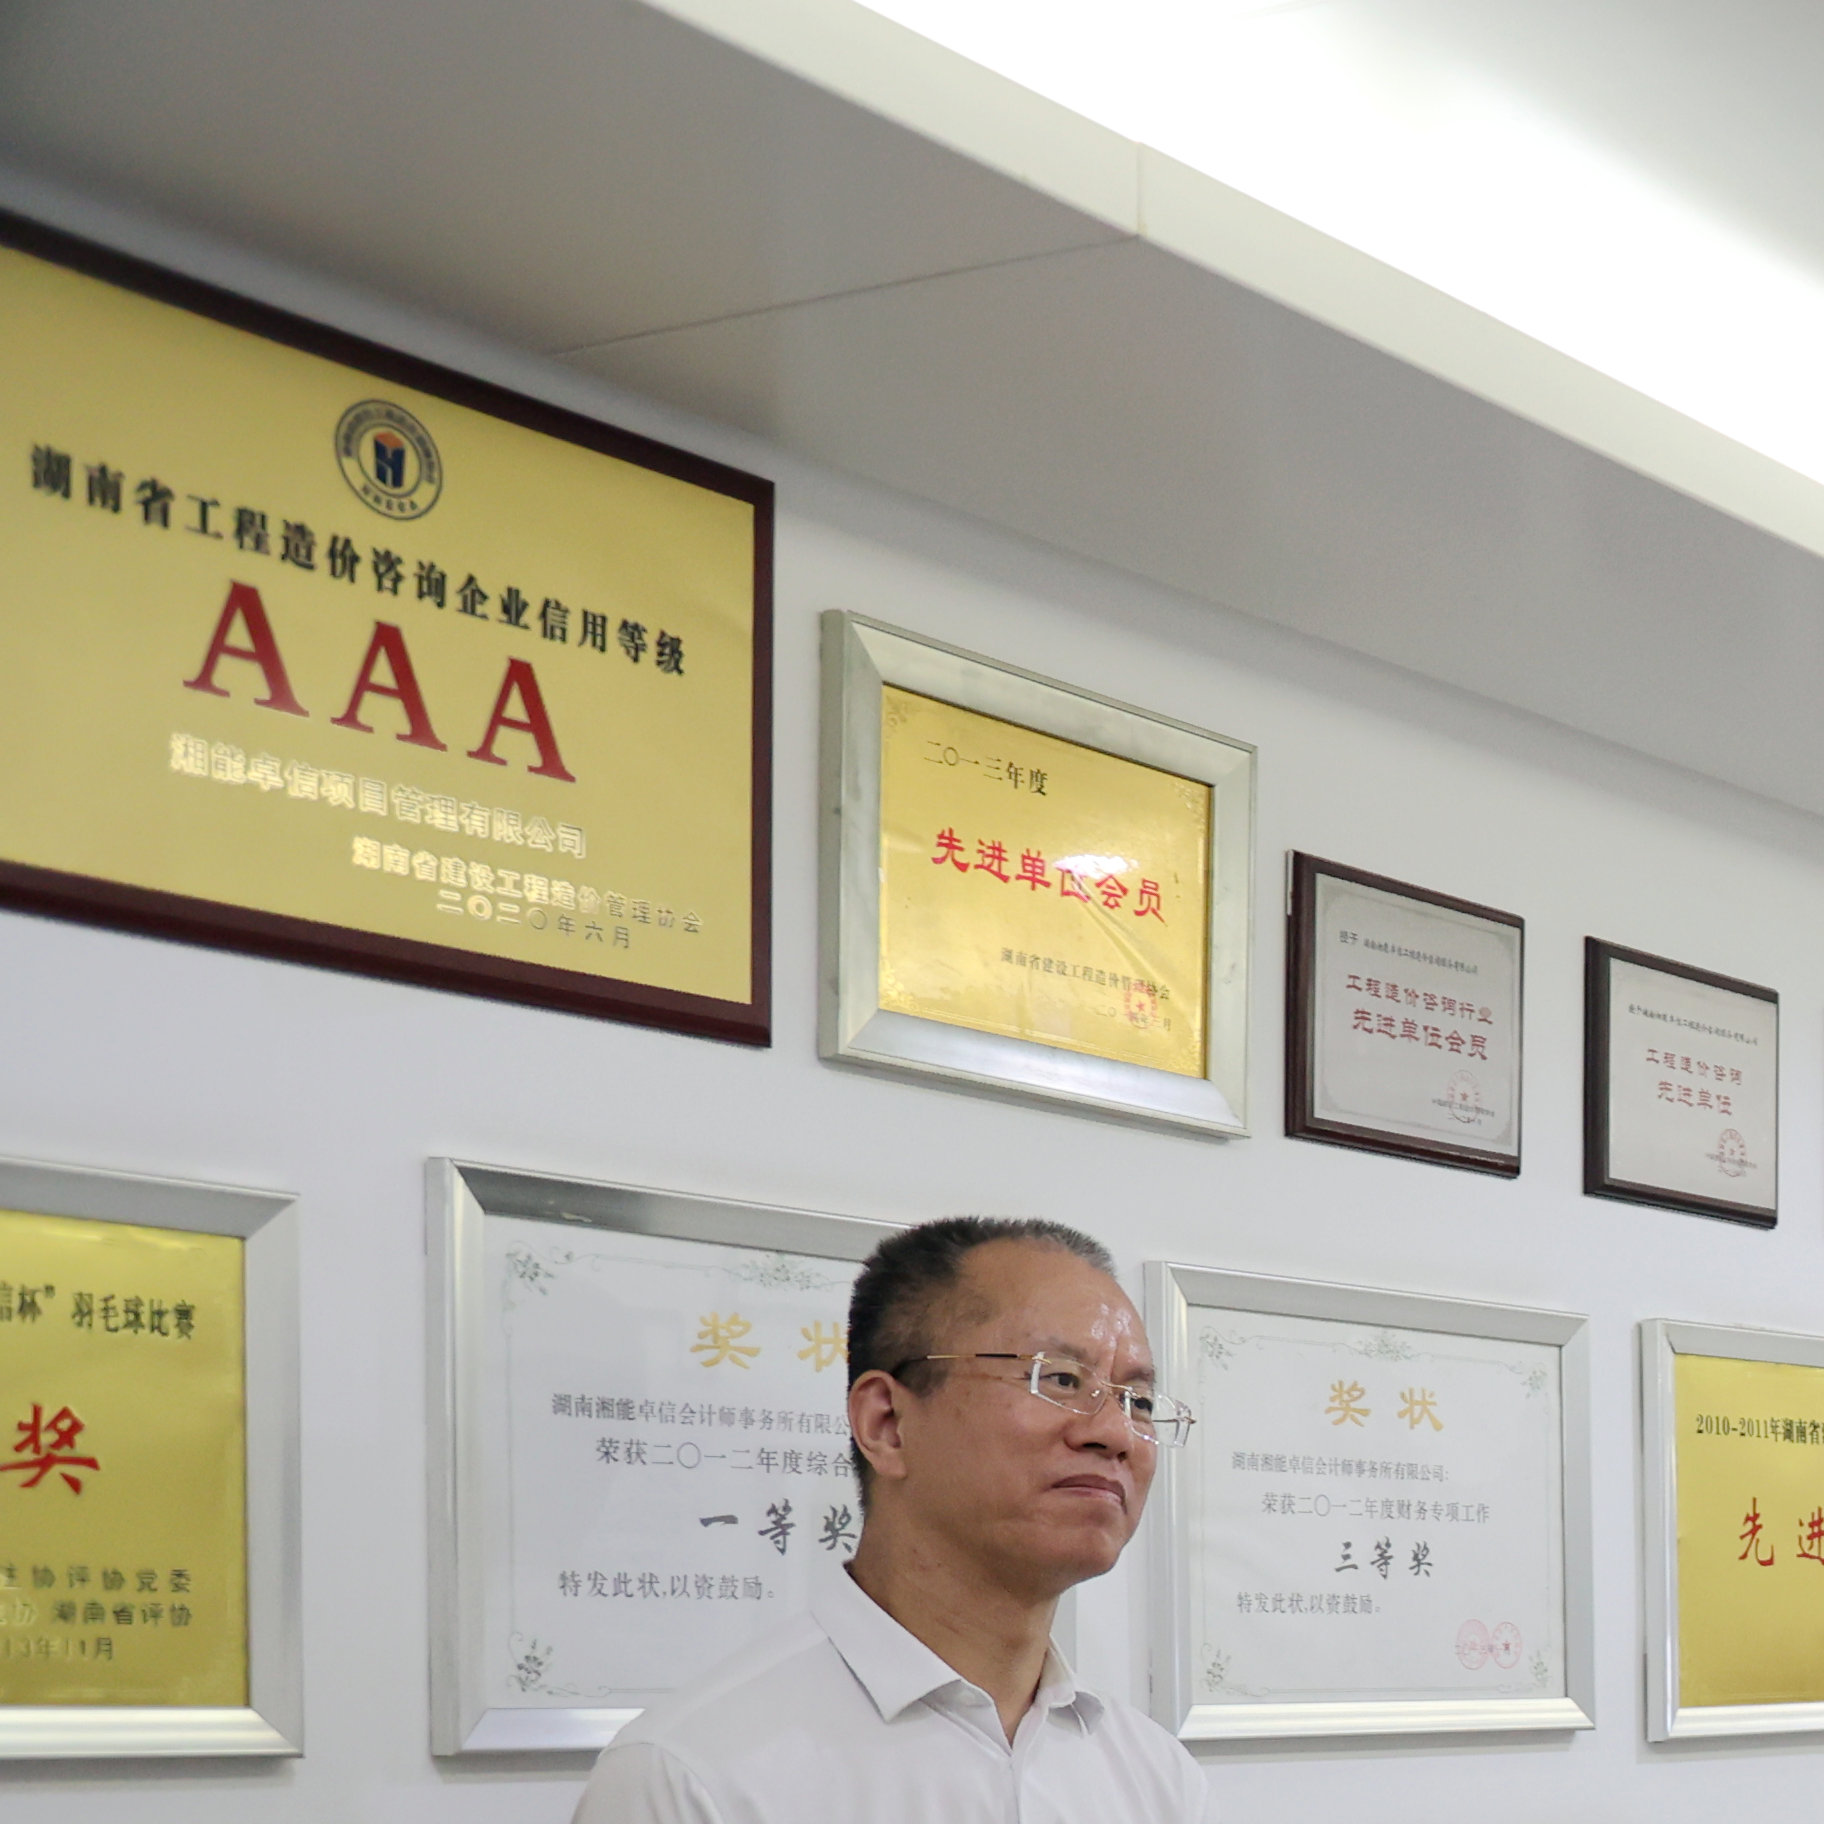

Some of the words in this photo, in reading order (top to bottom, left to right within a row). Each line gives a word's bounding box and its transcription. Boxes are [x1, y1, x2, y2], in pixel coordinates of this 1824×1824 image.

[31, 443, 687, 676] 湖南省工程造价咨询企业信用等级
[183, 579, 577, 785] AAA
[923, 740, 1049, 798] 二〇一三年度
[931, 828, 1168, 925] 先进单位会员
[1353, 1008, 1488, 1061] 先进单位会员
[72, 1291, 196, 1340] 羽毛球比赛
[1324, 1379, 1444, 1432] 奖状
[0, 1402, 101, 1496] 奖
[700, 1497, 859, 1556] 一等奖
[1334, 1536, 1434, 1579] 三等奖
